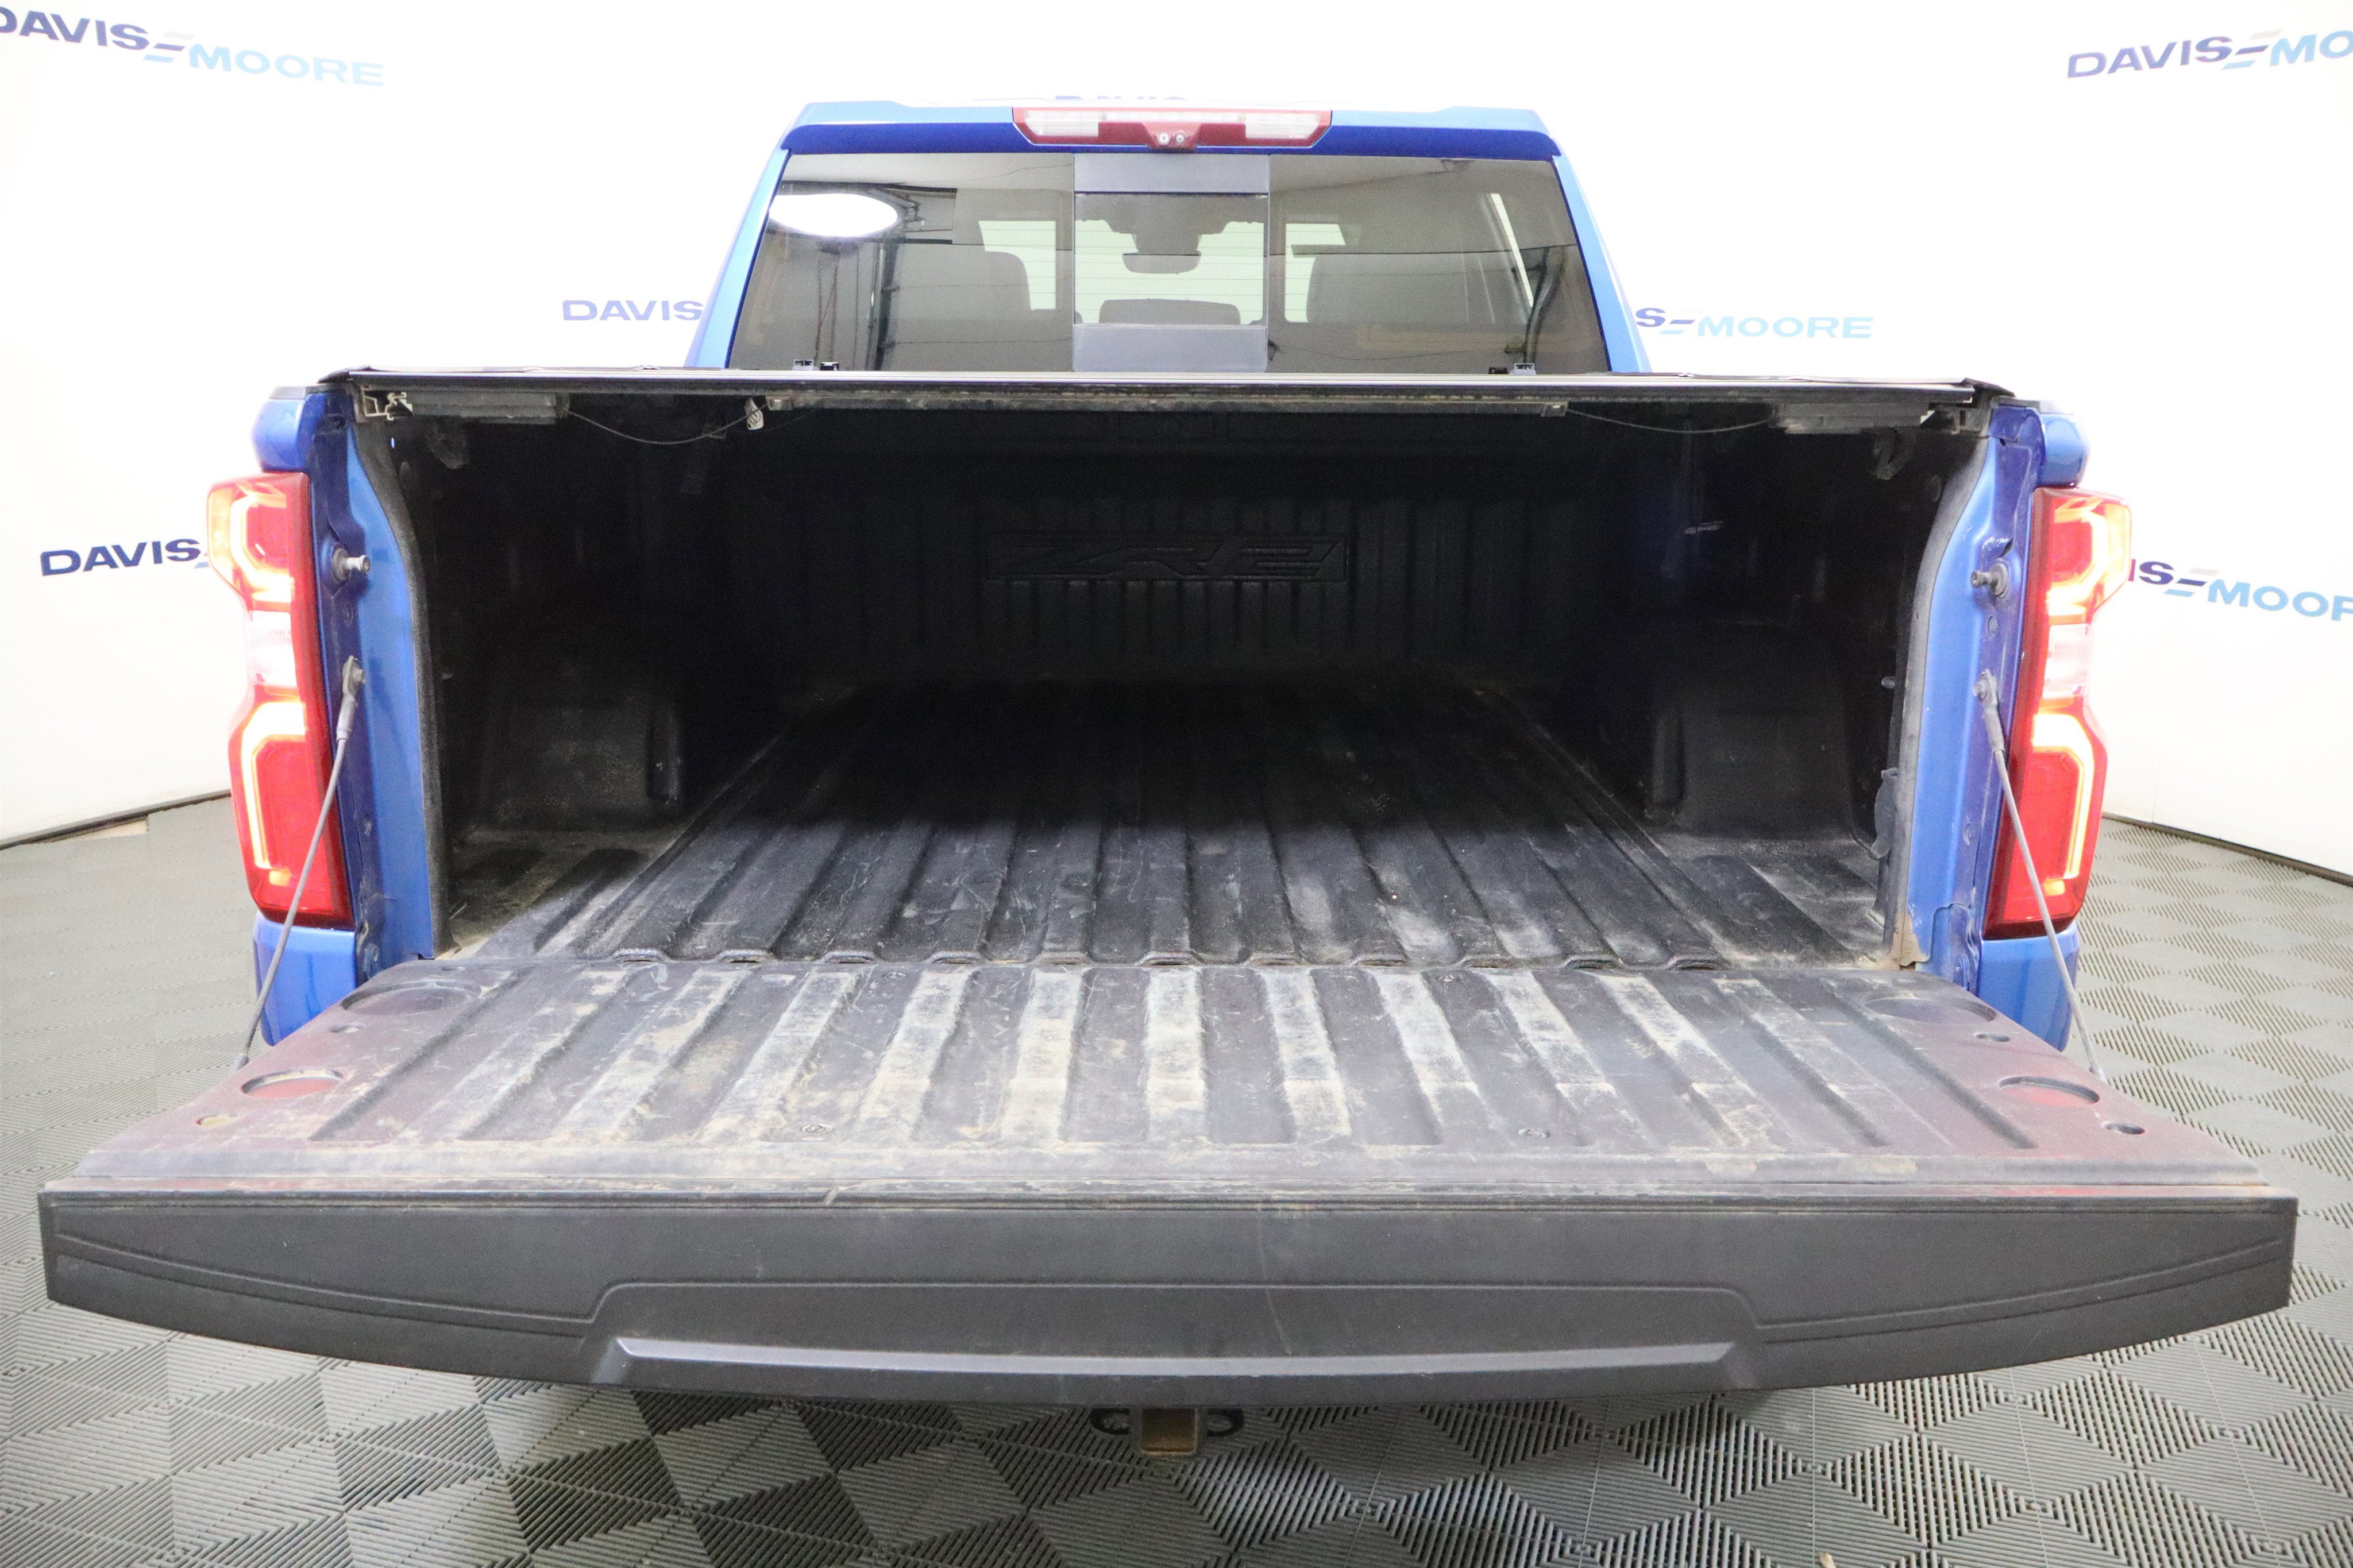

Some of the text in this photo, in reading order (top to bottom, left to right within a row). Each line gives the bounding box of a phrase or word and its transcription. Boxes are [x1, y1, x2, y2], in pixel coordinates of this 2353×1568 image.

[189, 44, 384, 86] MOORE
[2067, 36, 2233, 78] DAVIS
[562, 300, 704, 320] DAVIS
[1698, 316, 1873, 339] MOORE
[40, 538, 201, 576] DAVIS
